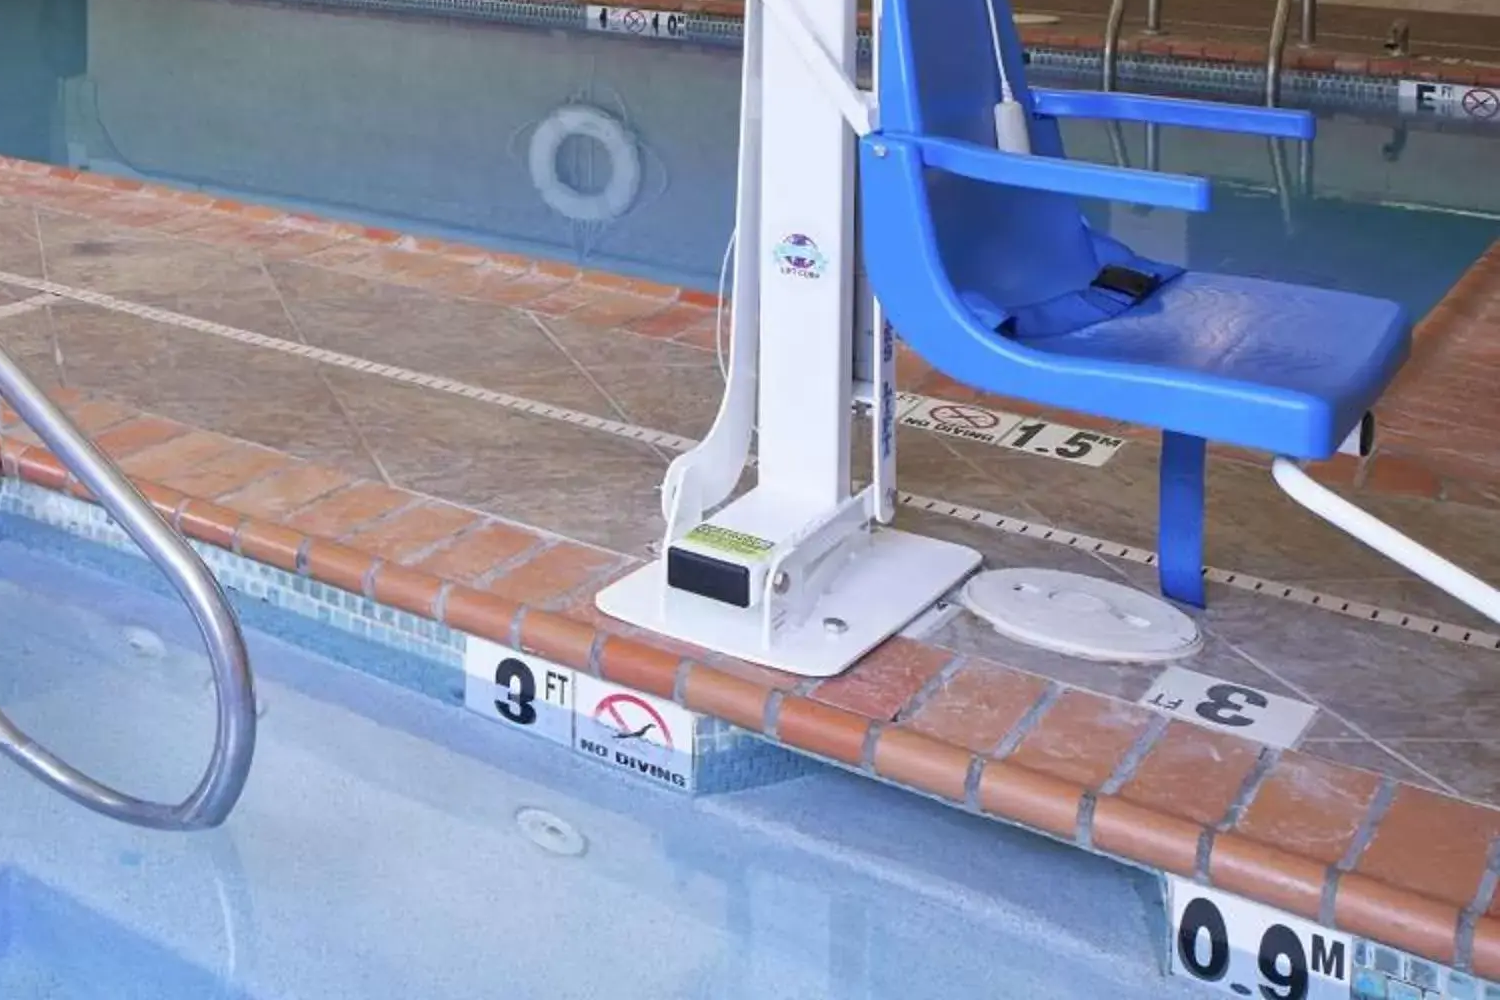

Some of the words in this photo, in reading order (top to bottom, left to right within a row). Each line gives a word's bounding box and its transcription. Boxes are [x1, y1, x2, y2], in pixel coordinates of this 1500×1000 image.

[905, 417, 930, 428] NO
[935, 421, 995, 442] DIVING
[1012, 422, 1101, 459] 1.5
[494, 657, 537, 725] 3
[545, 670, 569, 705] FT
[1196, 683, 1269, 727] 3
[580, 738, 609, 758] NO
[615, 750, 687, 788] DIVING
[1177, 897, 1309, 1000] 0.9
